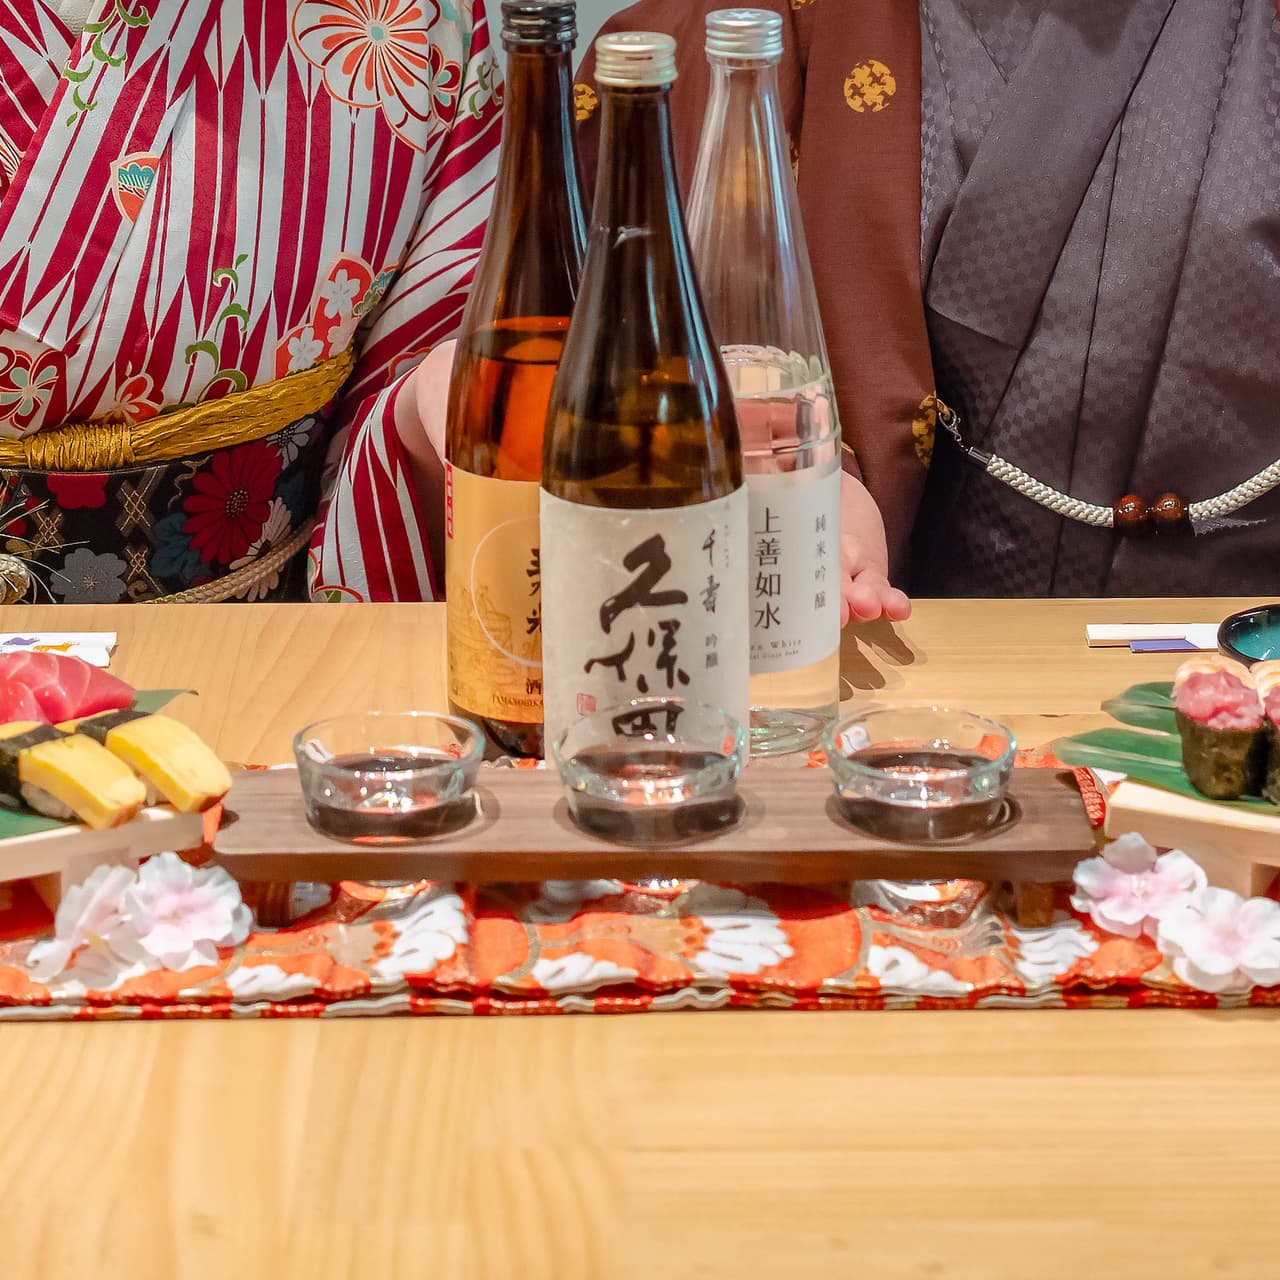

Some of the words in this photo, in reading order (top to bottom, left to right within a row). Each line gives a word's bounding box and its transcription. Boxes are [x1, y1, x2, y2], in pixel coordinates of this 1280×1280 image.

[584, 533, 691, 736] 久保田
[754, 506, 782, 630] 上善如水
